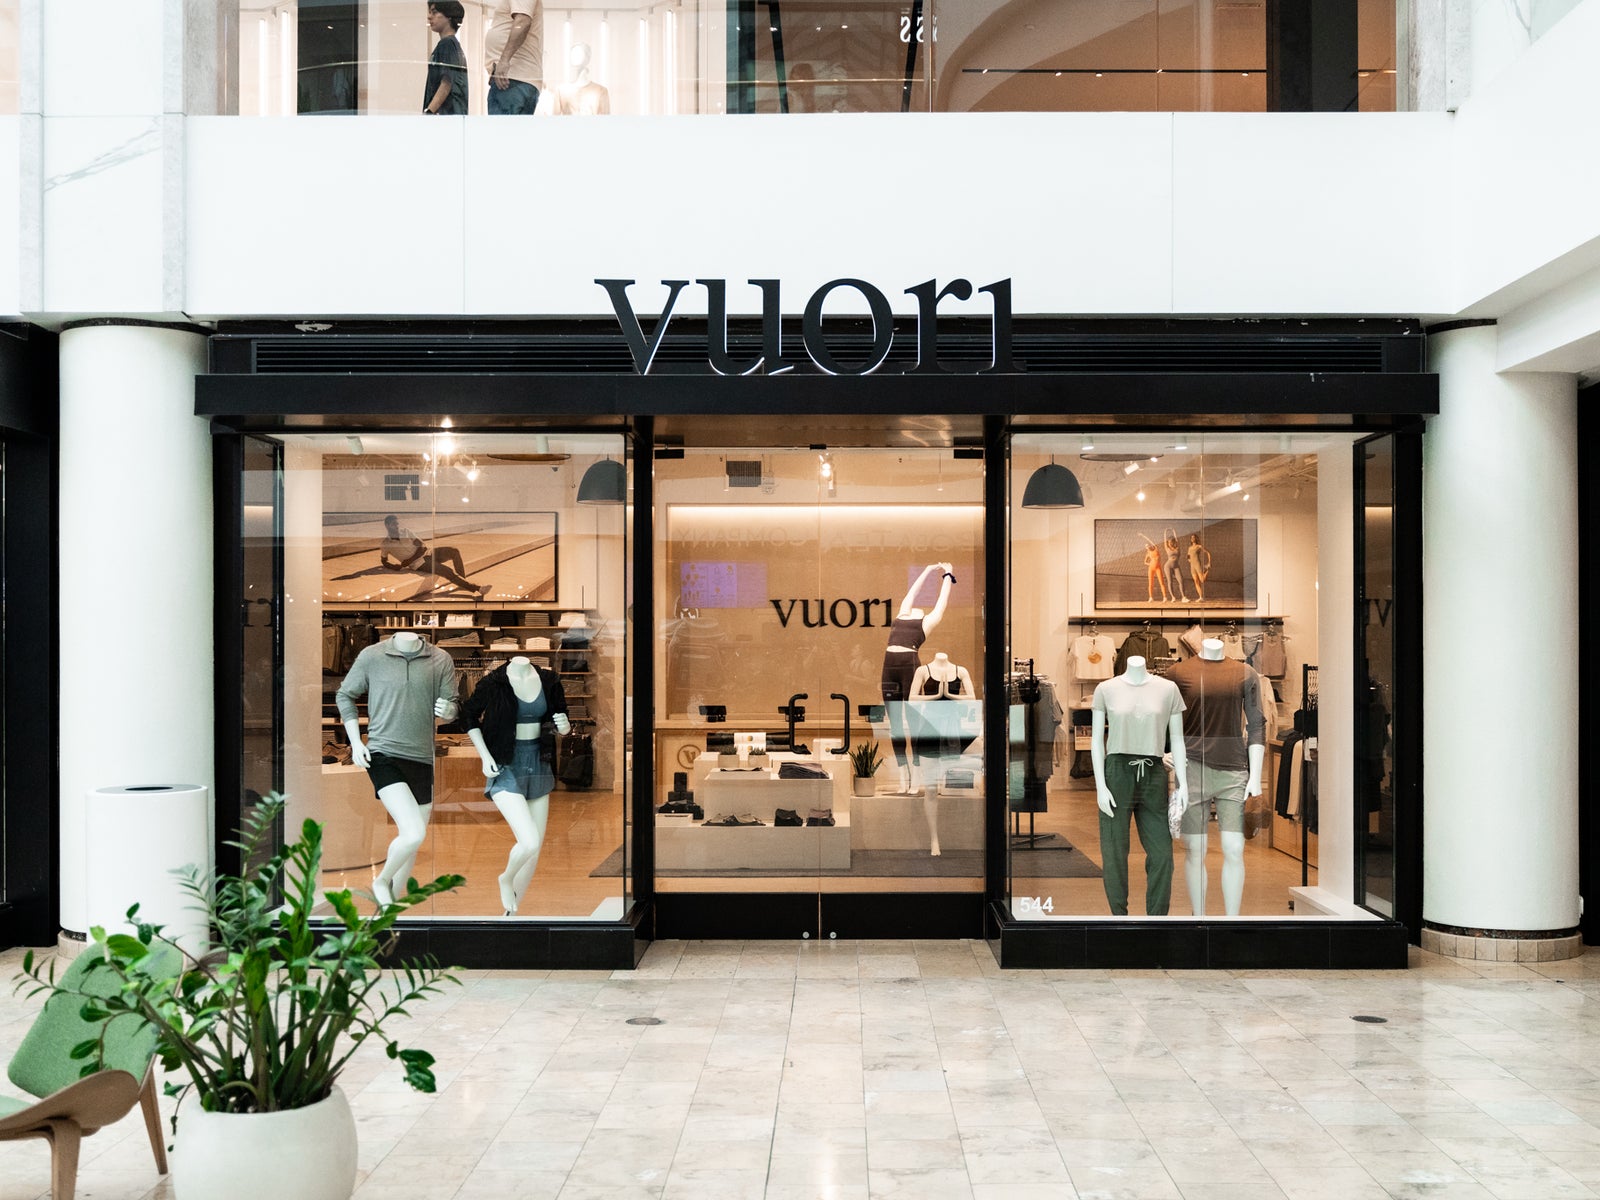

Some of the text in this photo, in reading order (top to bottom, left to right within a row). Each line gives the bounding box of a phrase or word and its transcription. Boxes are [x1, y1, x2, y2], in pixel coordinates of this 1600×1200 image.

[594, 277, 1027, 376] vuori
[770, 598, 892, 628] vuori
[1020, 896, 1054, 913] 544
